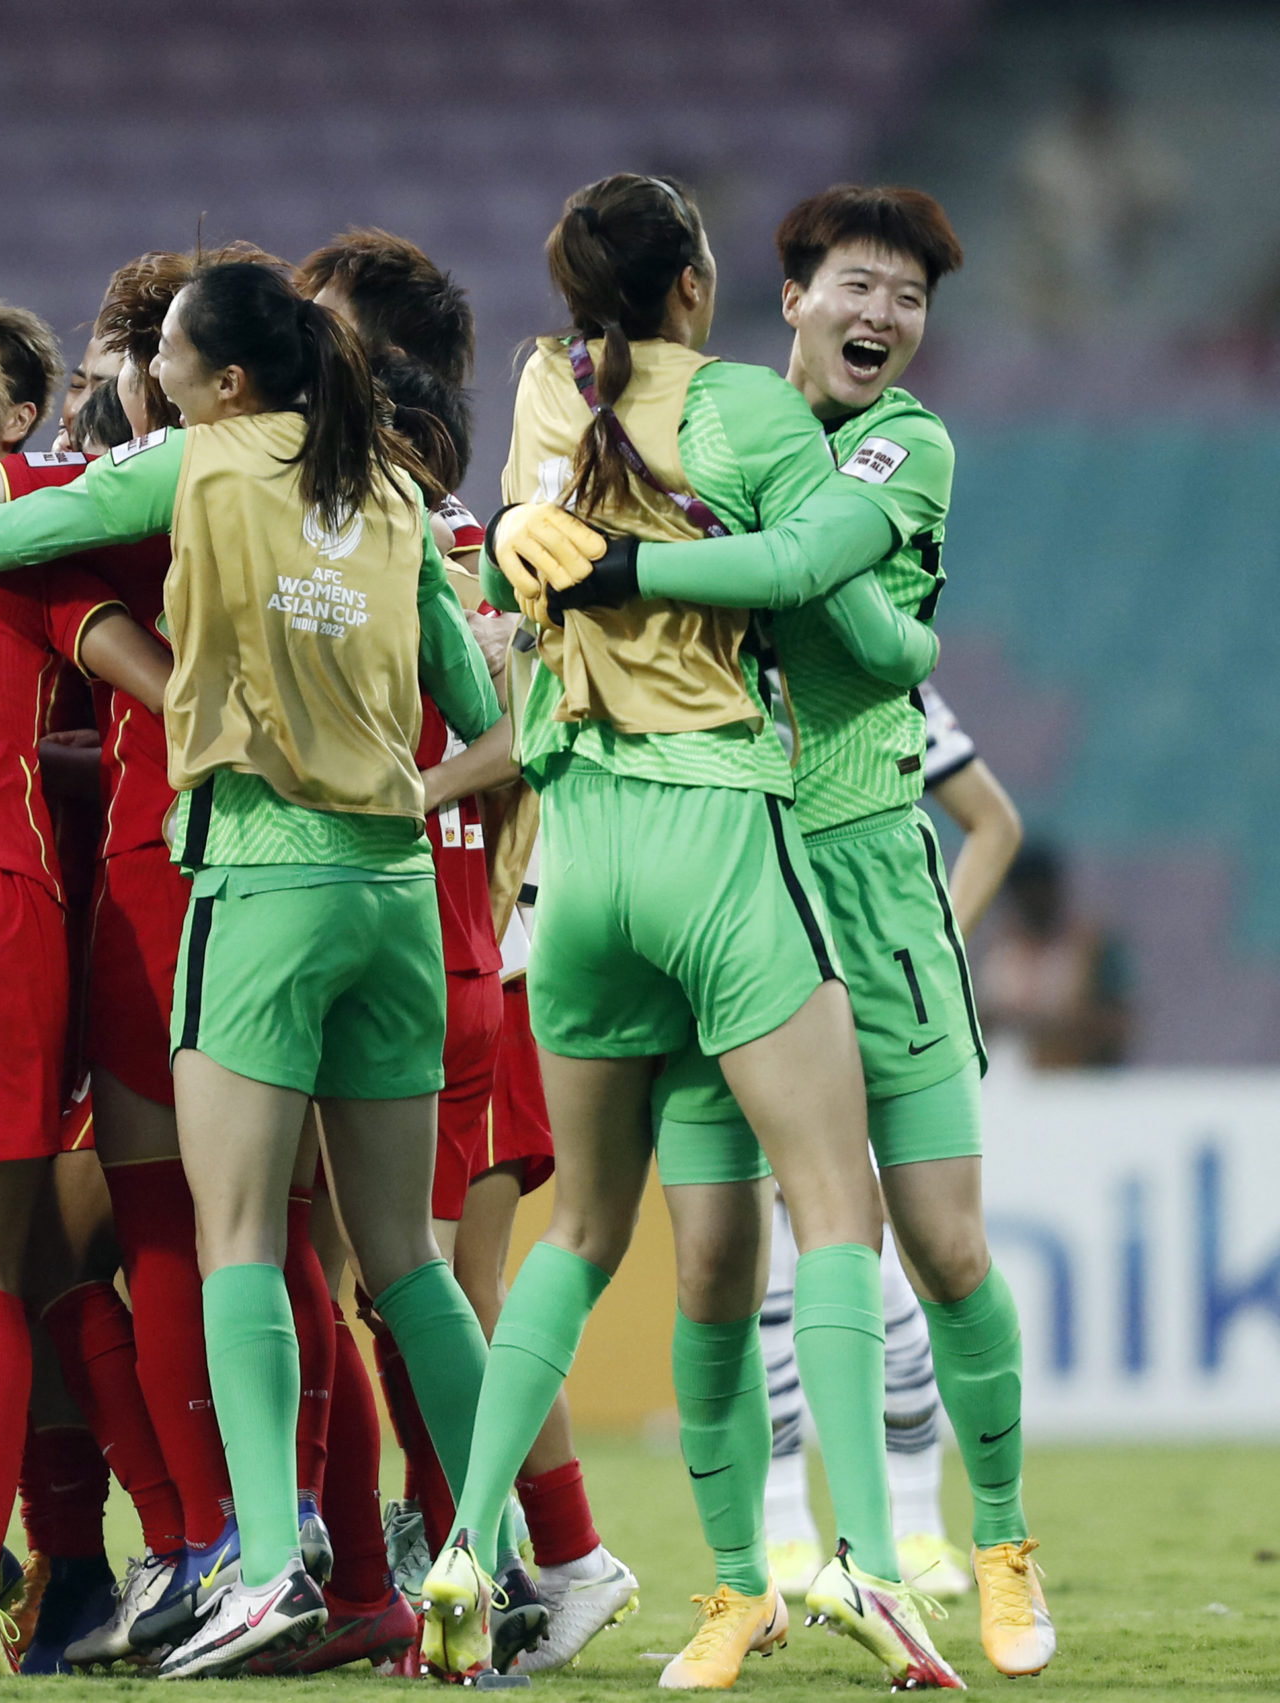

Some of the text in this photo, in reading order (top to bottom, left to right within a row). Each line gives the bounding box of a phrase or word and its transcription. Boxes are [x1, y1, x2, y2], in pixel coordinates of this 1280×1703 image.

[870, 461, 885, 475] ALL
[874, 452, 895, 469] GOAL
[311, 566, 344, 585] AFC
[277, 575, 367, 609] WOMEN'S
[267, 593, 368, 627] ASIAN CUP
[291, 616, 345, 638] INDIA 2022
[893, 948, 929, 1025] 1
